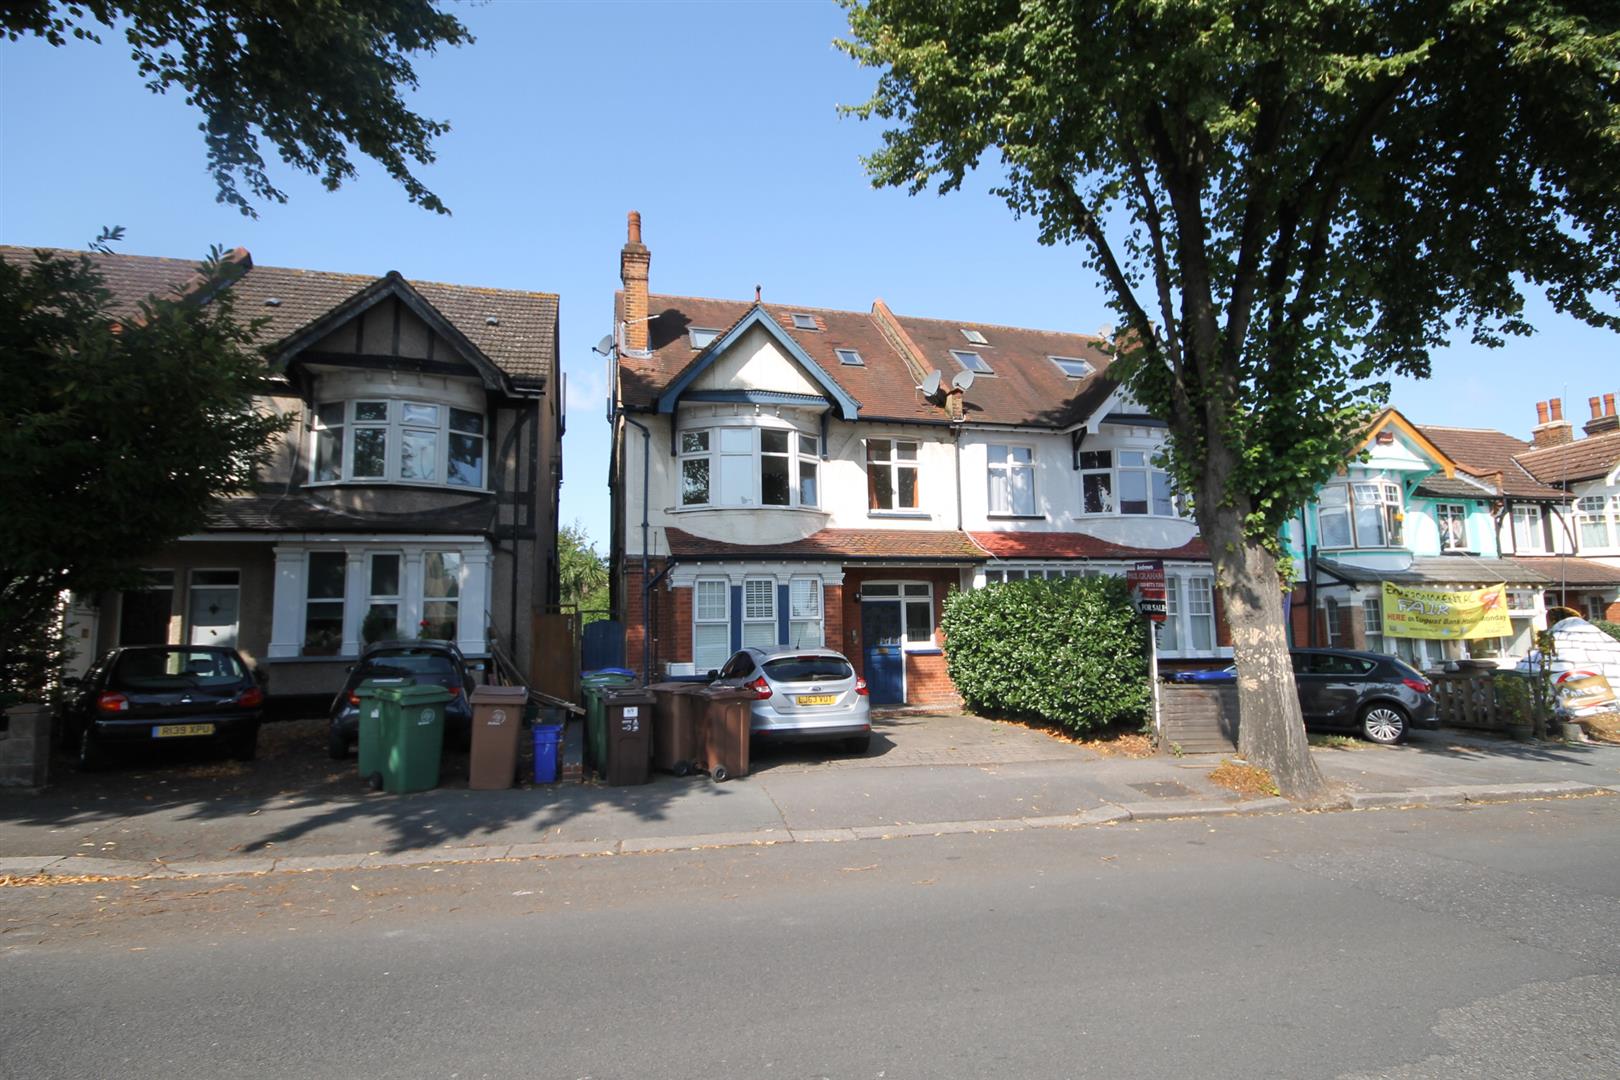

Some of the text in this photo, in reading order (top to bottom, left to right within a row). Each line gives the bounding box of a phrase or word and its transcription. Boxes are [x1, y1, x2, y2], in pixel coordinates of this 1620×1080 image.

[1397, 599, 1450, 616] FAIR
[1387, 613, 1407, 622] HERE
[162, 724, 210, 736] R139 XPU
